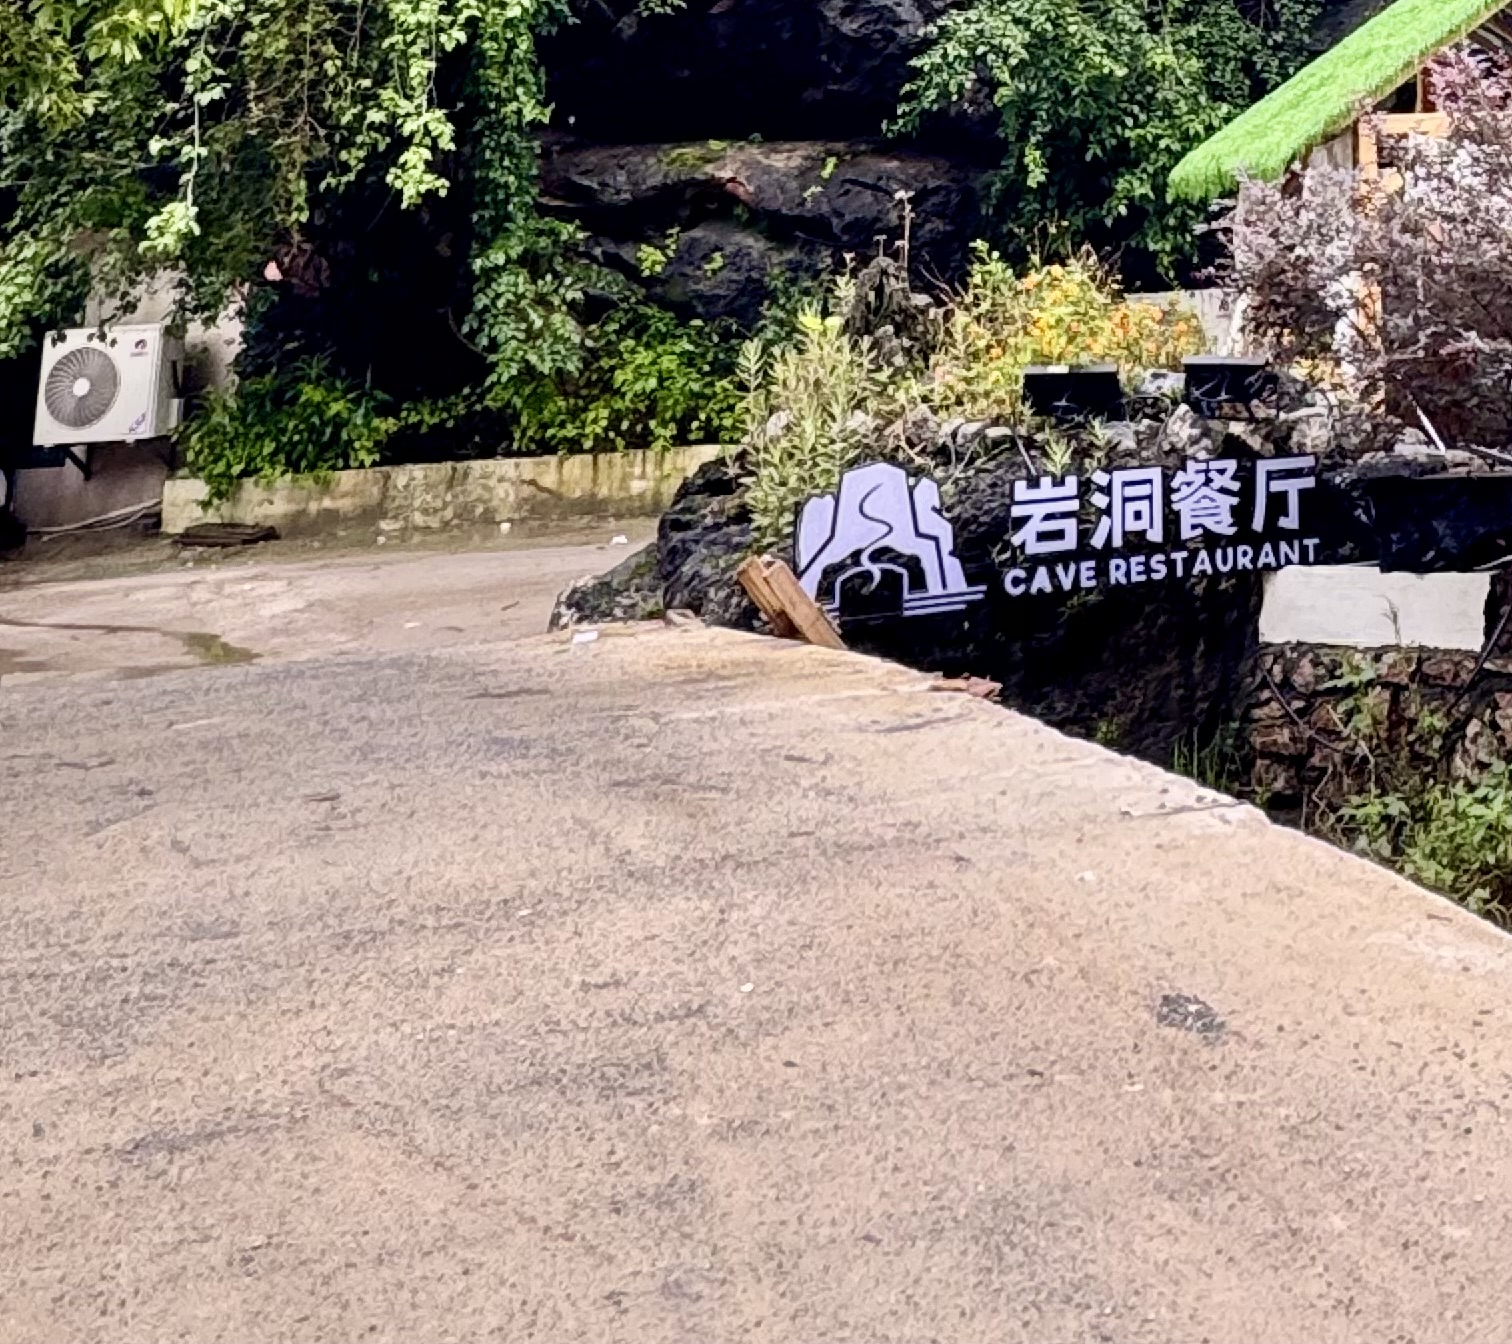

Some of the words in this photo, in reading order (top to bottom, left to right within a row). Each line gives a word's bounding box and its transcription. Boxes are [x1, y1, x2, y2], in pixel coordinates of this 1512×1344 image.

[1010, 455, 1316, 555] 岩洞餐厅
[1004, 560, 1098, 596] CAVE
[1109, 537, 1320, 585] RESTAURANT
